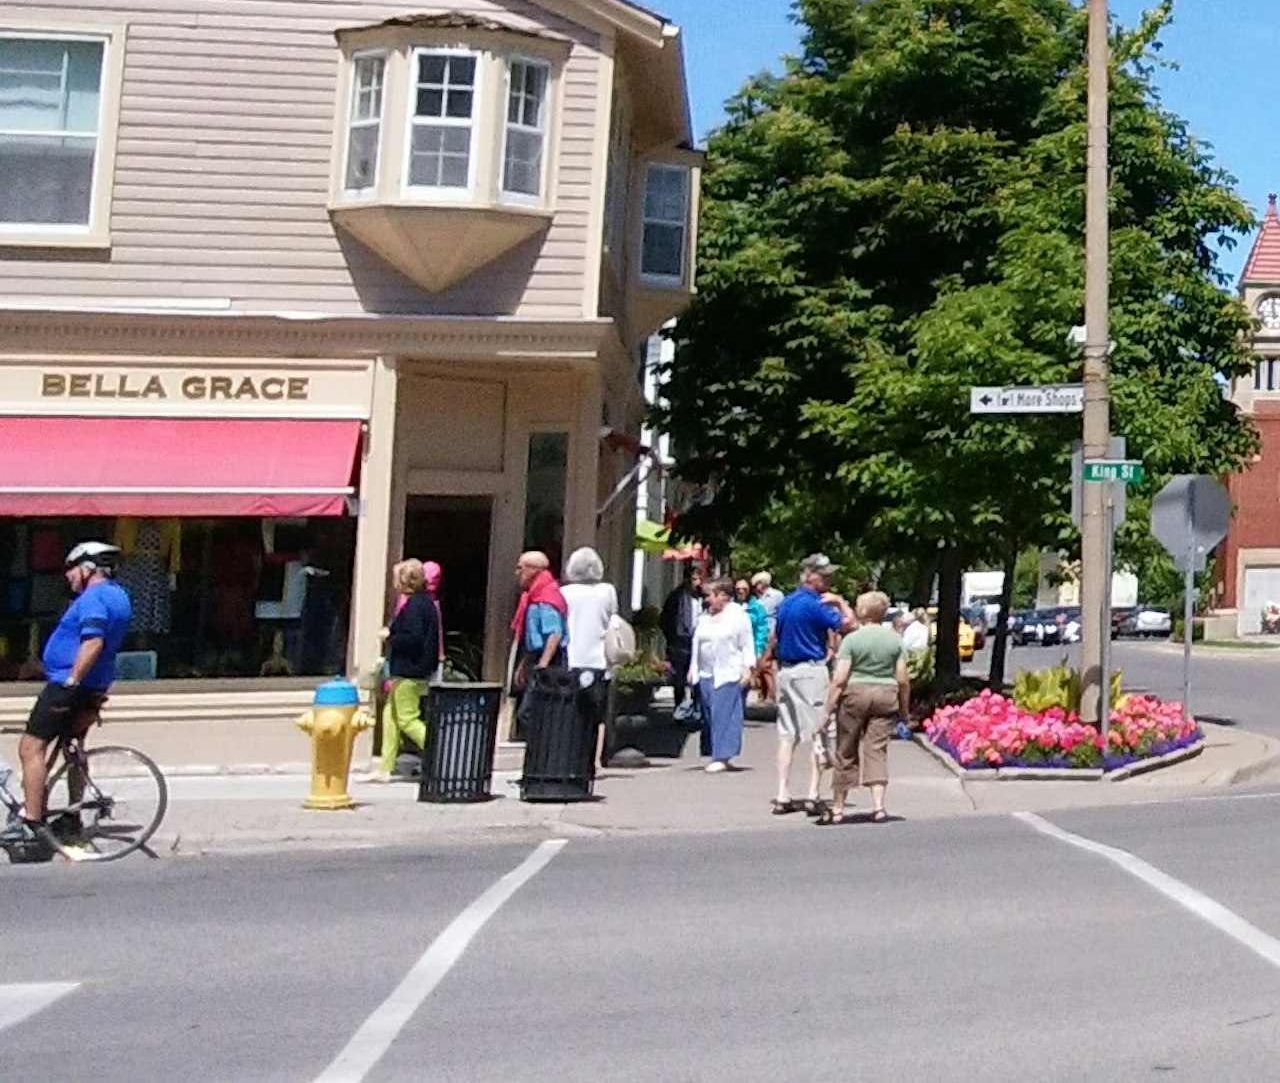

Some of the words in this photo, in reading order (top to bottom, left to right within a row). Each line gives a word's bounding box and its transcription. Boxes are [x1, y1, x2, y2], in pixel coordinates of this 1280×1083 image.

[41, 373, 167, 398] BELLA
[181, 376, 309, 400] GRACE
[1018, 393, 1042, 406] More
[1045, 392, 1076, 409] Shops
[1091, 464, 1117, 482] King
[1120, 464, 1134, 479] St
